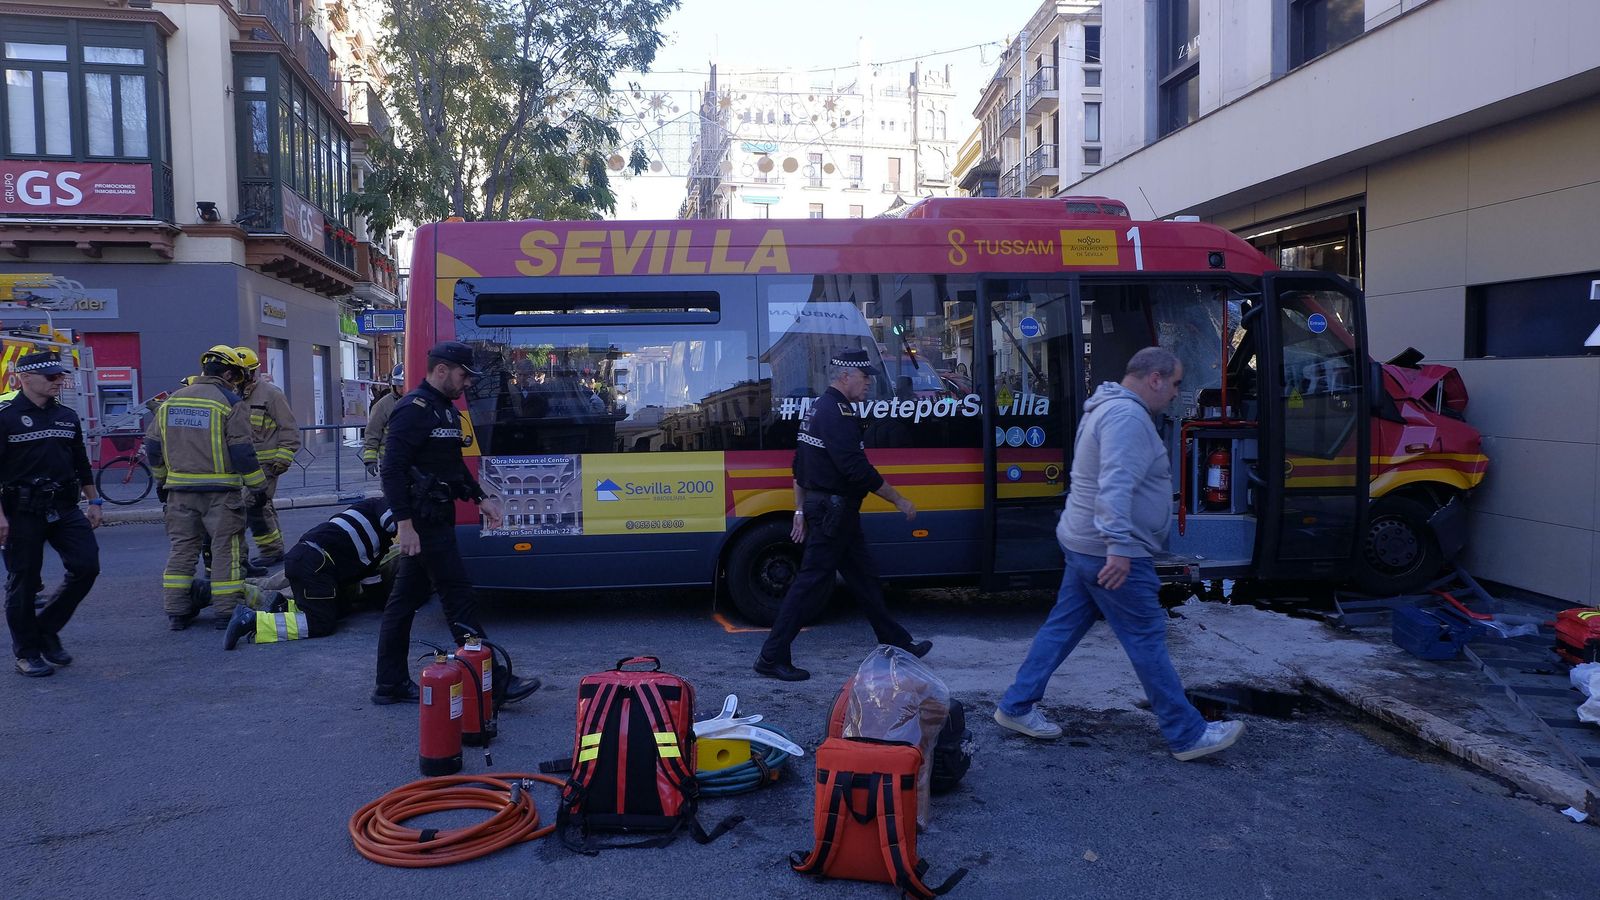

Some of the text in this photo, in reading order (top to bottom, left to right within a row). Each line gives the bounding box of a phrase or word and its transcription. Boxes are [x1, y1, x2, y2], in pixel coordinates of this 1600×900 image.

[4, 173, 15, 204] GRUPO
[16, 170, 83, 206] GS
[300, 204, 313, 241] GS
[514, 229, 791, 277] SEVILLA
[973, 239, 1054, 255] TUSSAM
[1125, 226, 1144, 271] 1
[169, 407, 210, 417] BOMBEROS
[174, 418, 202, 427] SEVILLA
[625, 480, 714, 495] Sevilla 2000
